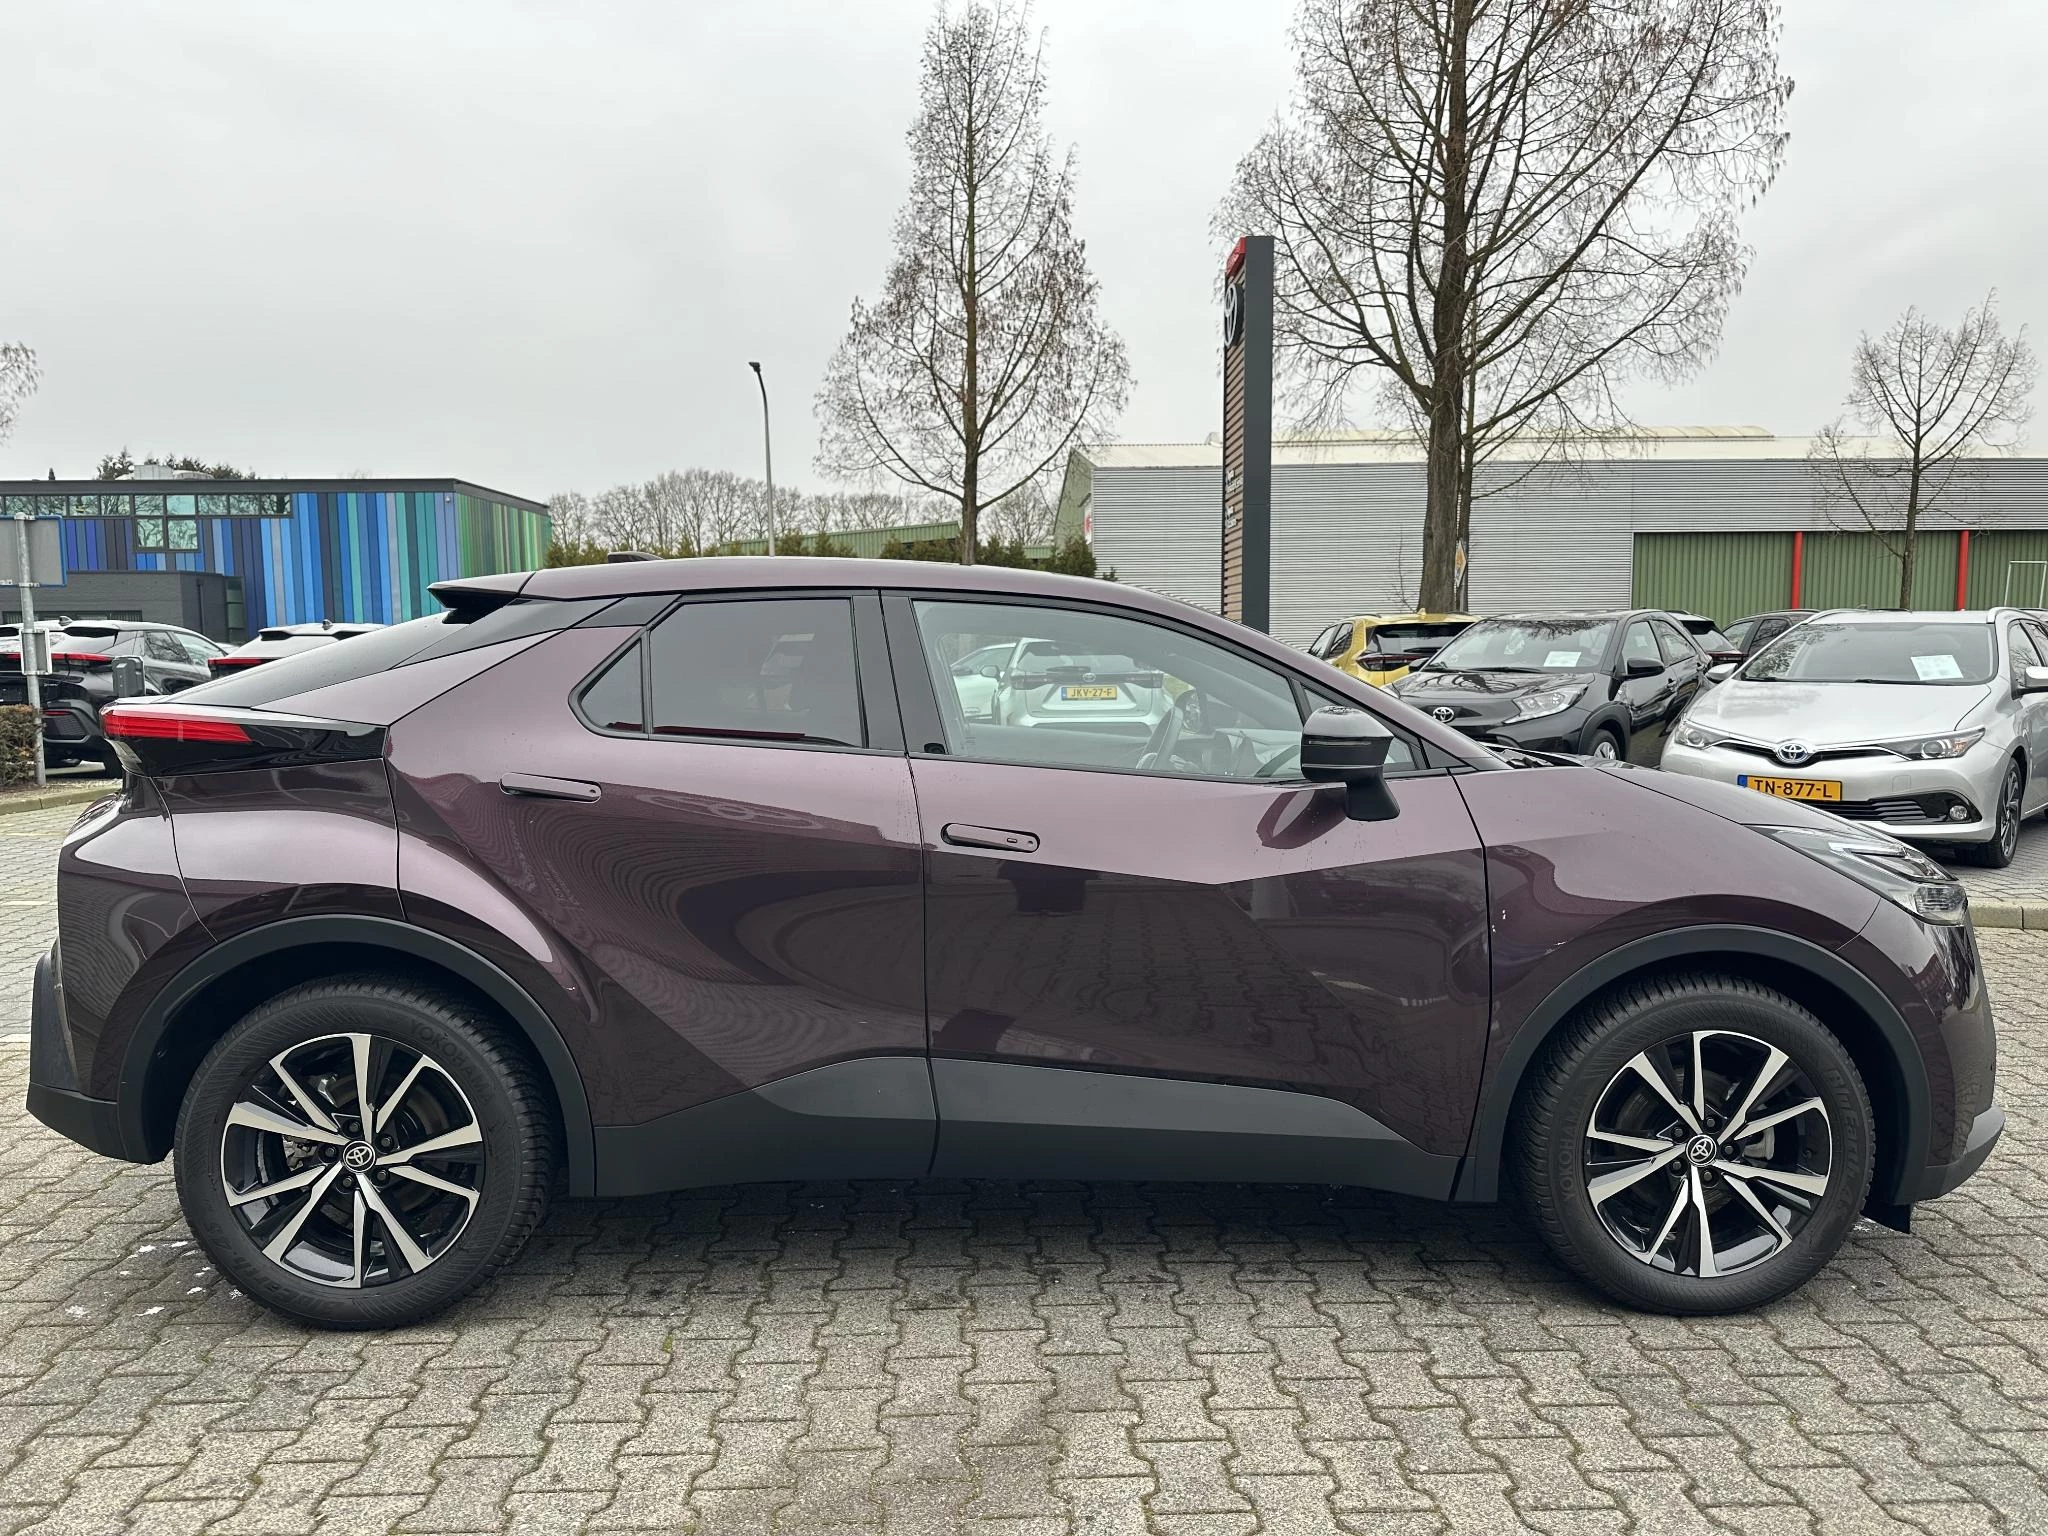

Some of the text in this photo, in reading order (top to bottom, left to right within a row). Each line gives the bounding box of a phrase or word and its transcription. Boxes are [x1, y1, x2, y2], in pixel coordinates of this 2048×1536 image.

[1071, 688, 1112, 697] JKV-27-F
[1754, 779, 1832, 797] TN-877-L
[408, 1018, 494, 1104] YOKOHAMA
[1558, 1094, 1586, 1201] YOKOHAMA
